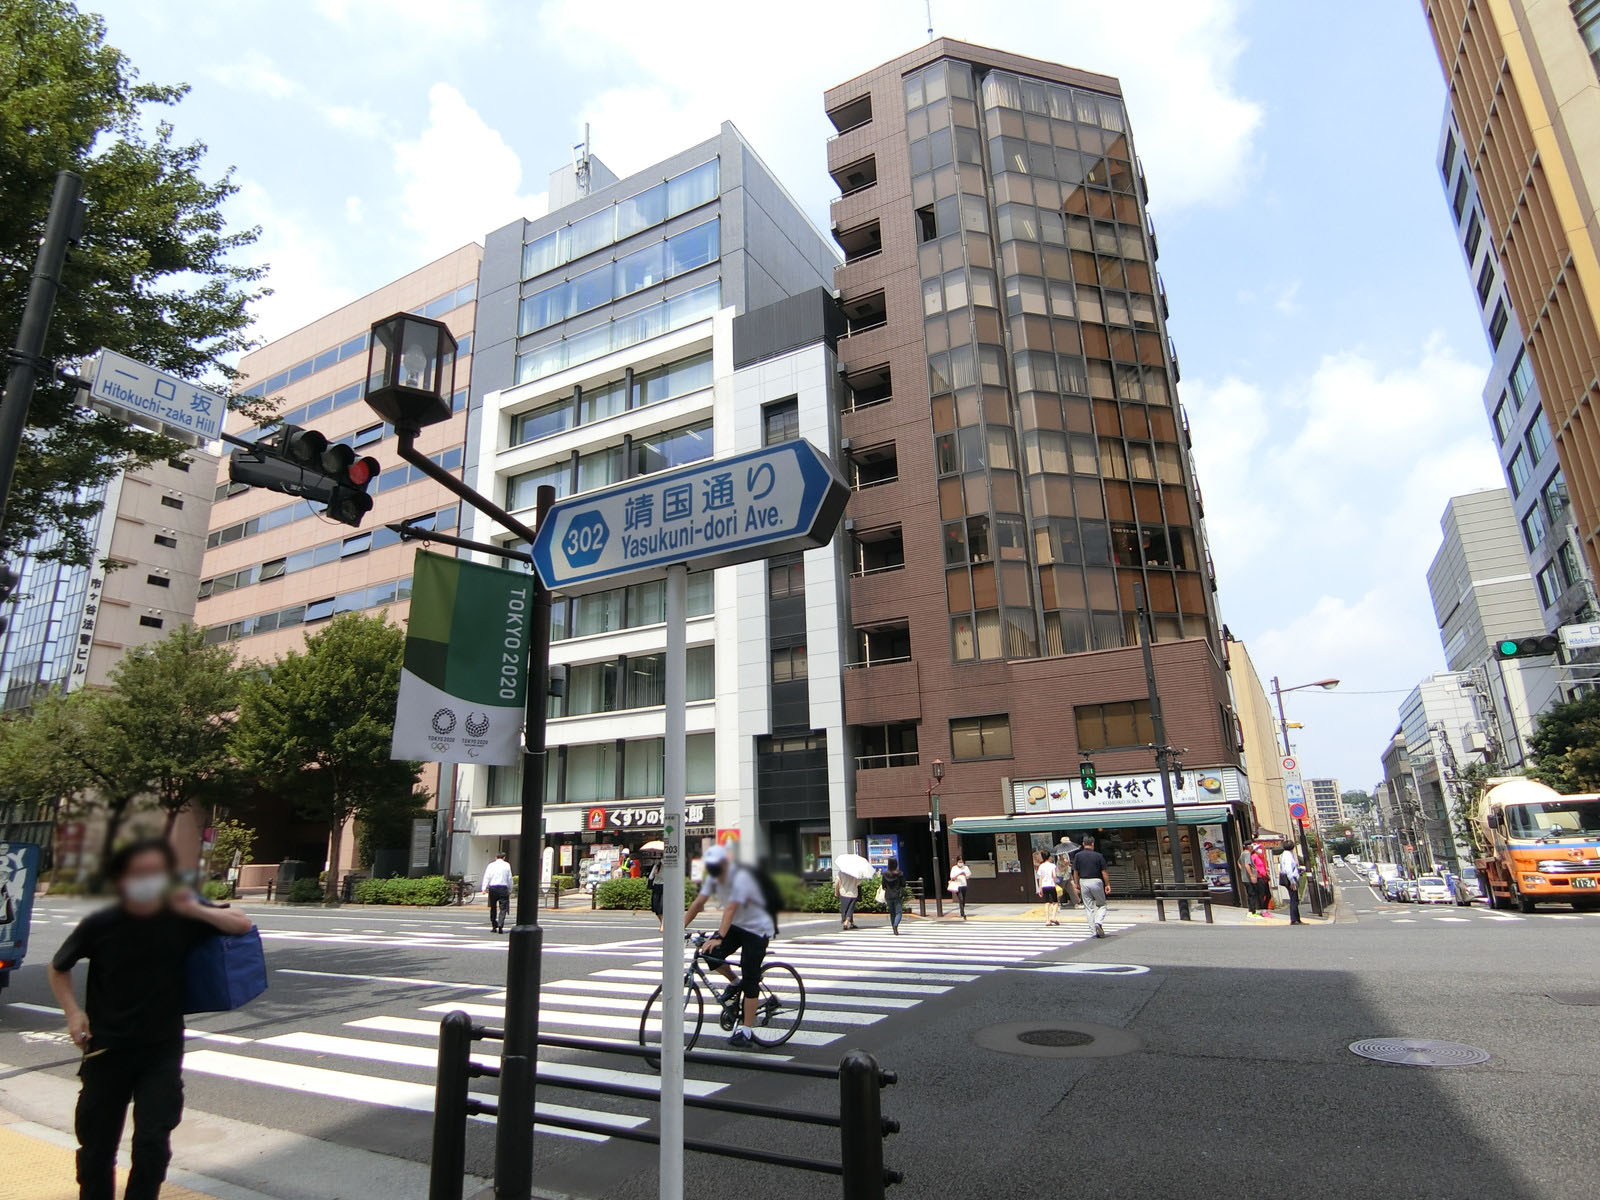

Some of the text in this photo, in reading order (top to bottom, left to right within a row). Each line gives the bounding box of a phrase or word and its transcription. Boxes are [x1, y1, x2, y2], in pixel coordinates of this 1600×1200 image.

[102, 379, 216, 434] Hitokuchi-zaka Hill
[114, 368, 213, 417] 一口坂
[624, 462, 776, 532] 靖国通り
[567, 523, 604, 555] 302
[621, 504, 784, 560] Yasukuni-dori Ave.
[499, 588, 526, 699] TOKYO 2020
[610, 805, 704, 827] くすりの郎
